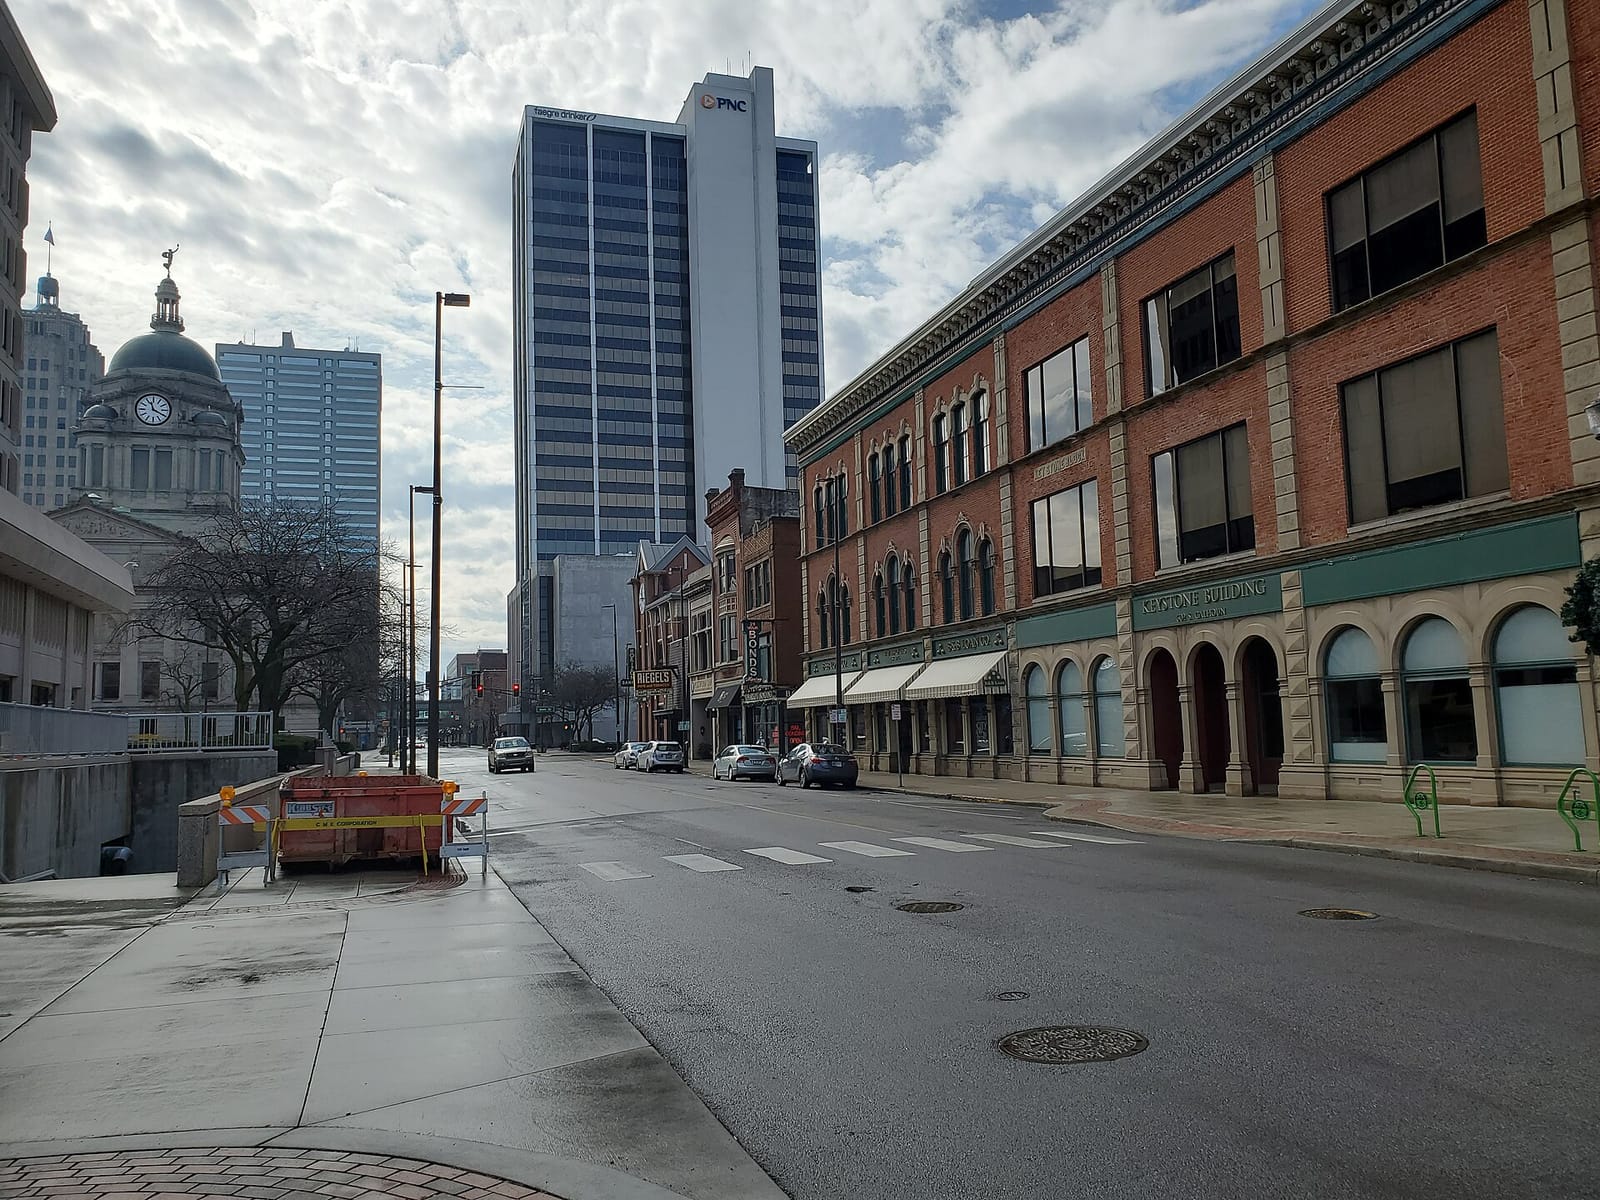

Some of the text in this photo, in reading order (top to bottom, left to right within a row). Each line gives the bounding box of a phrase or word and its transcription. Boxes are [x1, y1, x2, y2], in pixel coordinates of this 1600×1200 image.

[534, 108, 587, 121] faegre drinker
[716, 97, 747, 112] PNC
[1142, 579, 1267, 614] KEYSTONE BUILDING
[748, 630, 758, 677] BONDS
